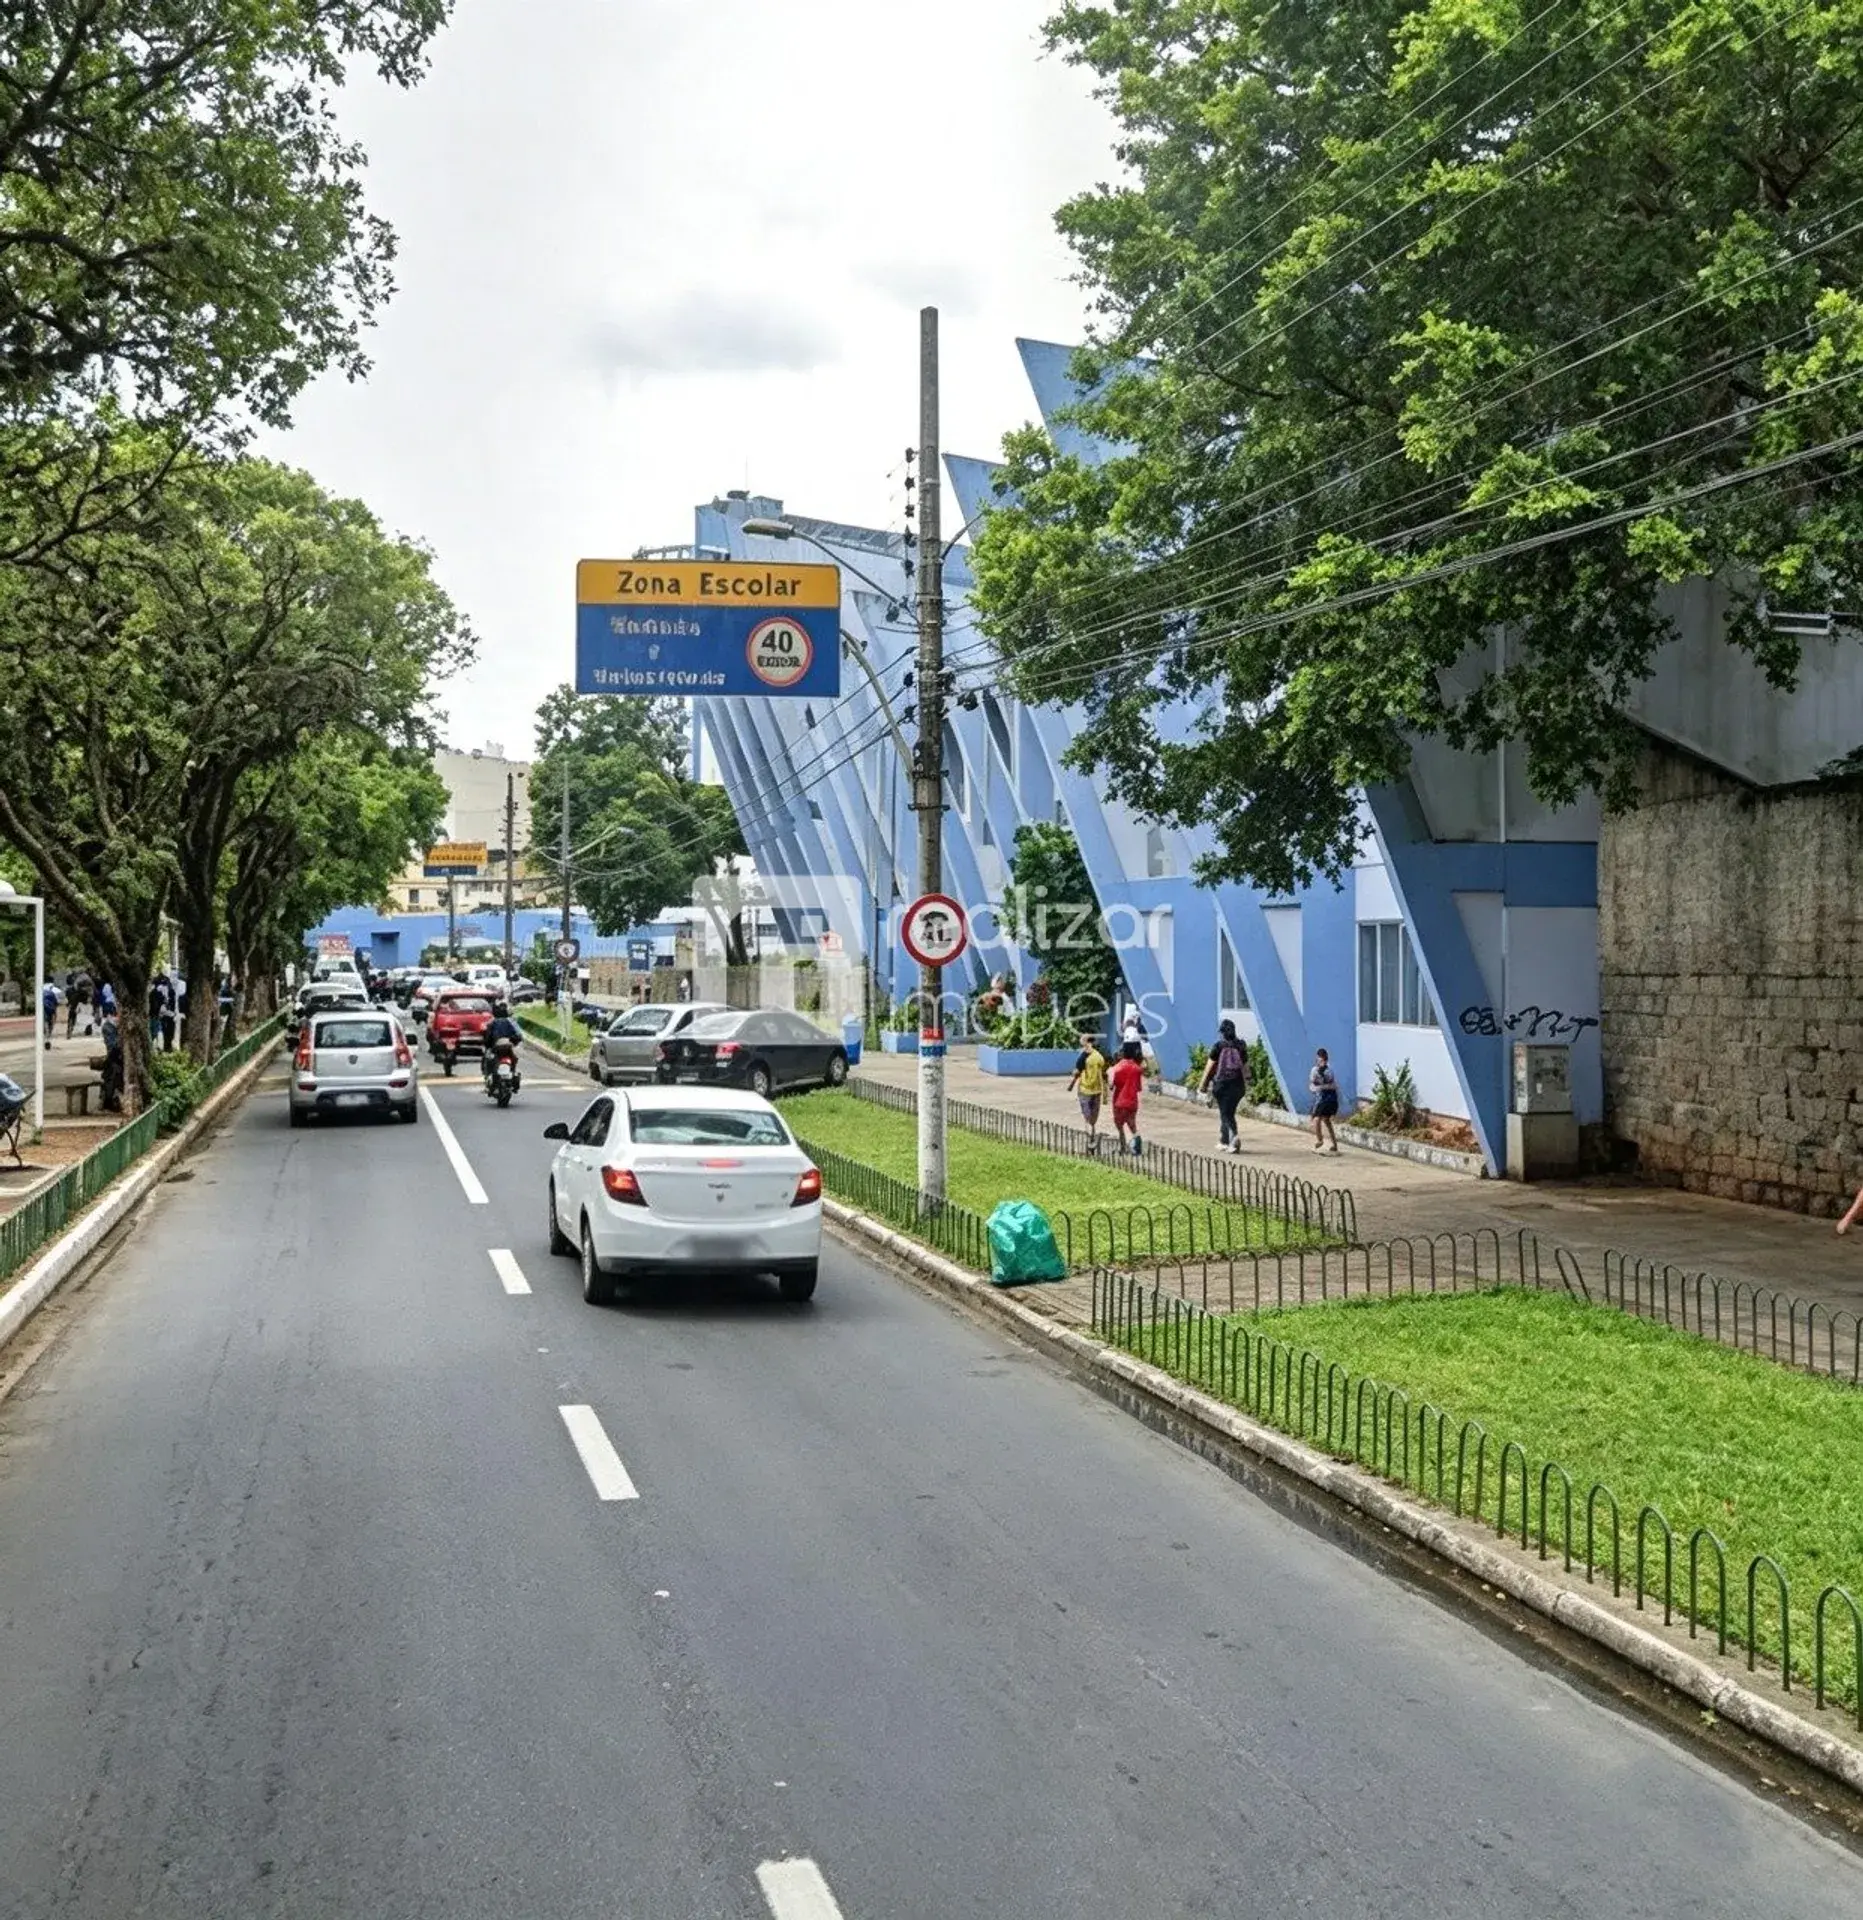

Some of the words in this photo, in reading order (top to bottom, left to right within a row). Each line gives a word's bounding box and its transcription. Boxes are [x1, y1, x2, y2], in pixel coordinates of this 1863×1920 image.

[617, 570, 681, 595] Zona
[700, 572, 801, 596] Escolar
[761, 629, 793, 653] 40
